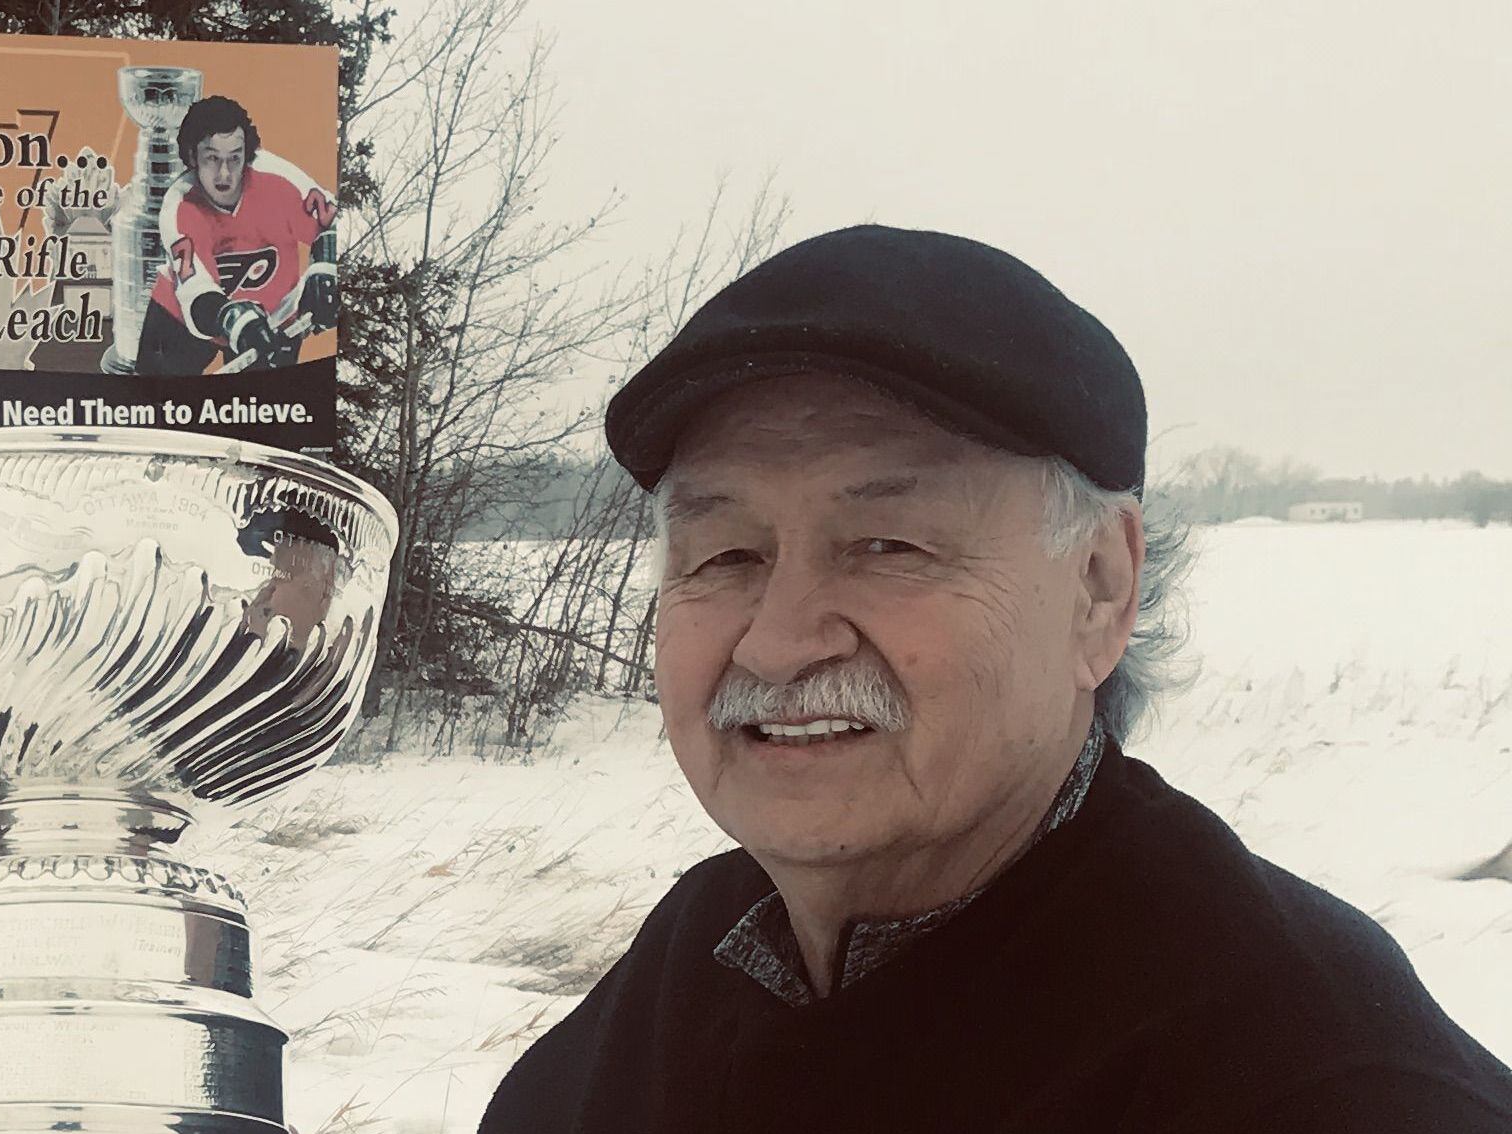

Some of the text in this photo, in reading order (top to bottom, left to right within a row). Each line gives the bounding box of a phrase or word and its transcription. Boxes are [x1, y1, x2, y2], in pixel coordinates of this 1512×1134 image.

[17, 179, 55, 208] of
[60, 180, 109, 209] the
[3, 400, 74, 427] Need
[80, 400, 156, 426] Them
[163, 402, 192, 426] to
[199, 396, 314, 426] Achieve.
